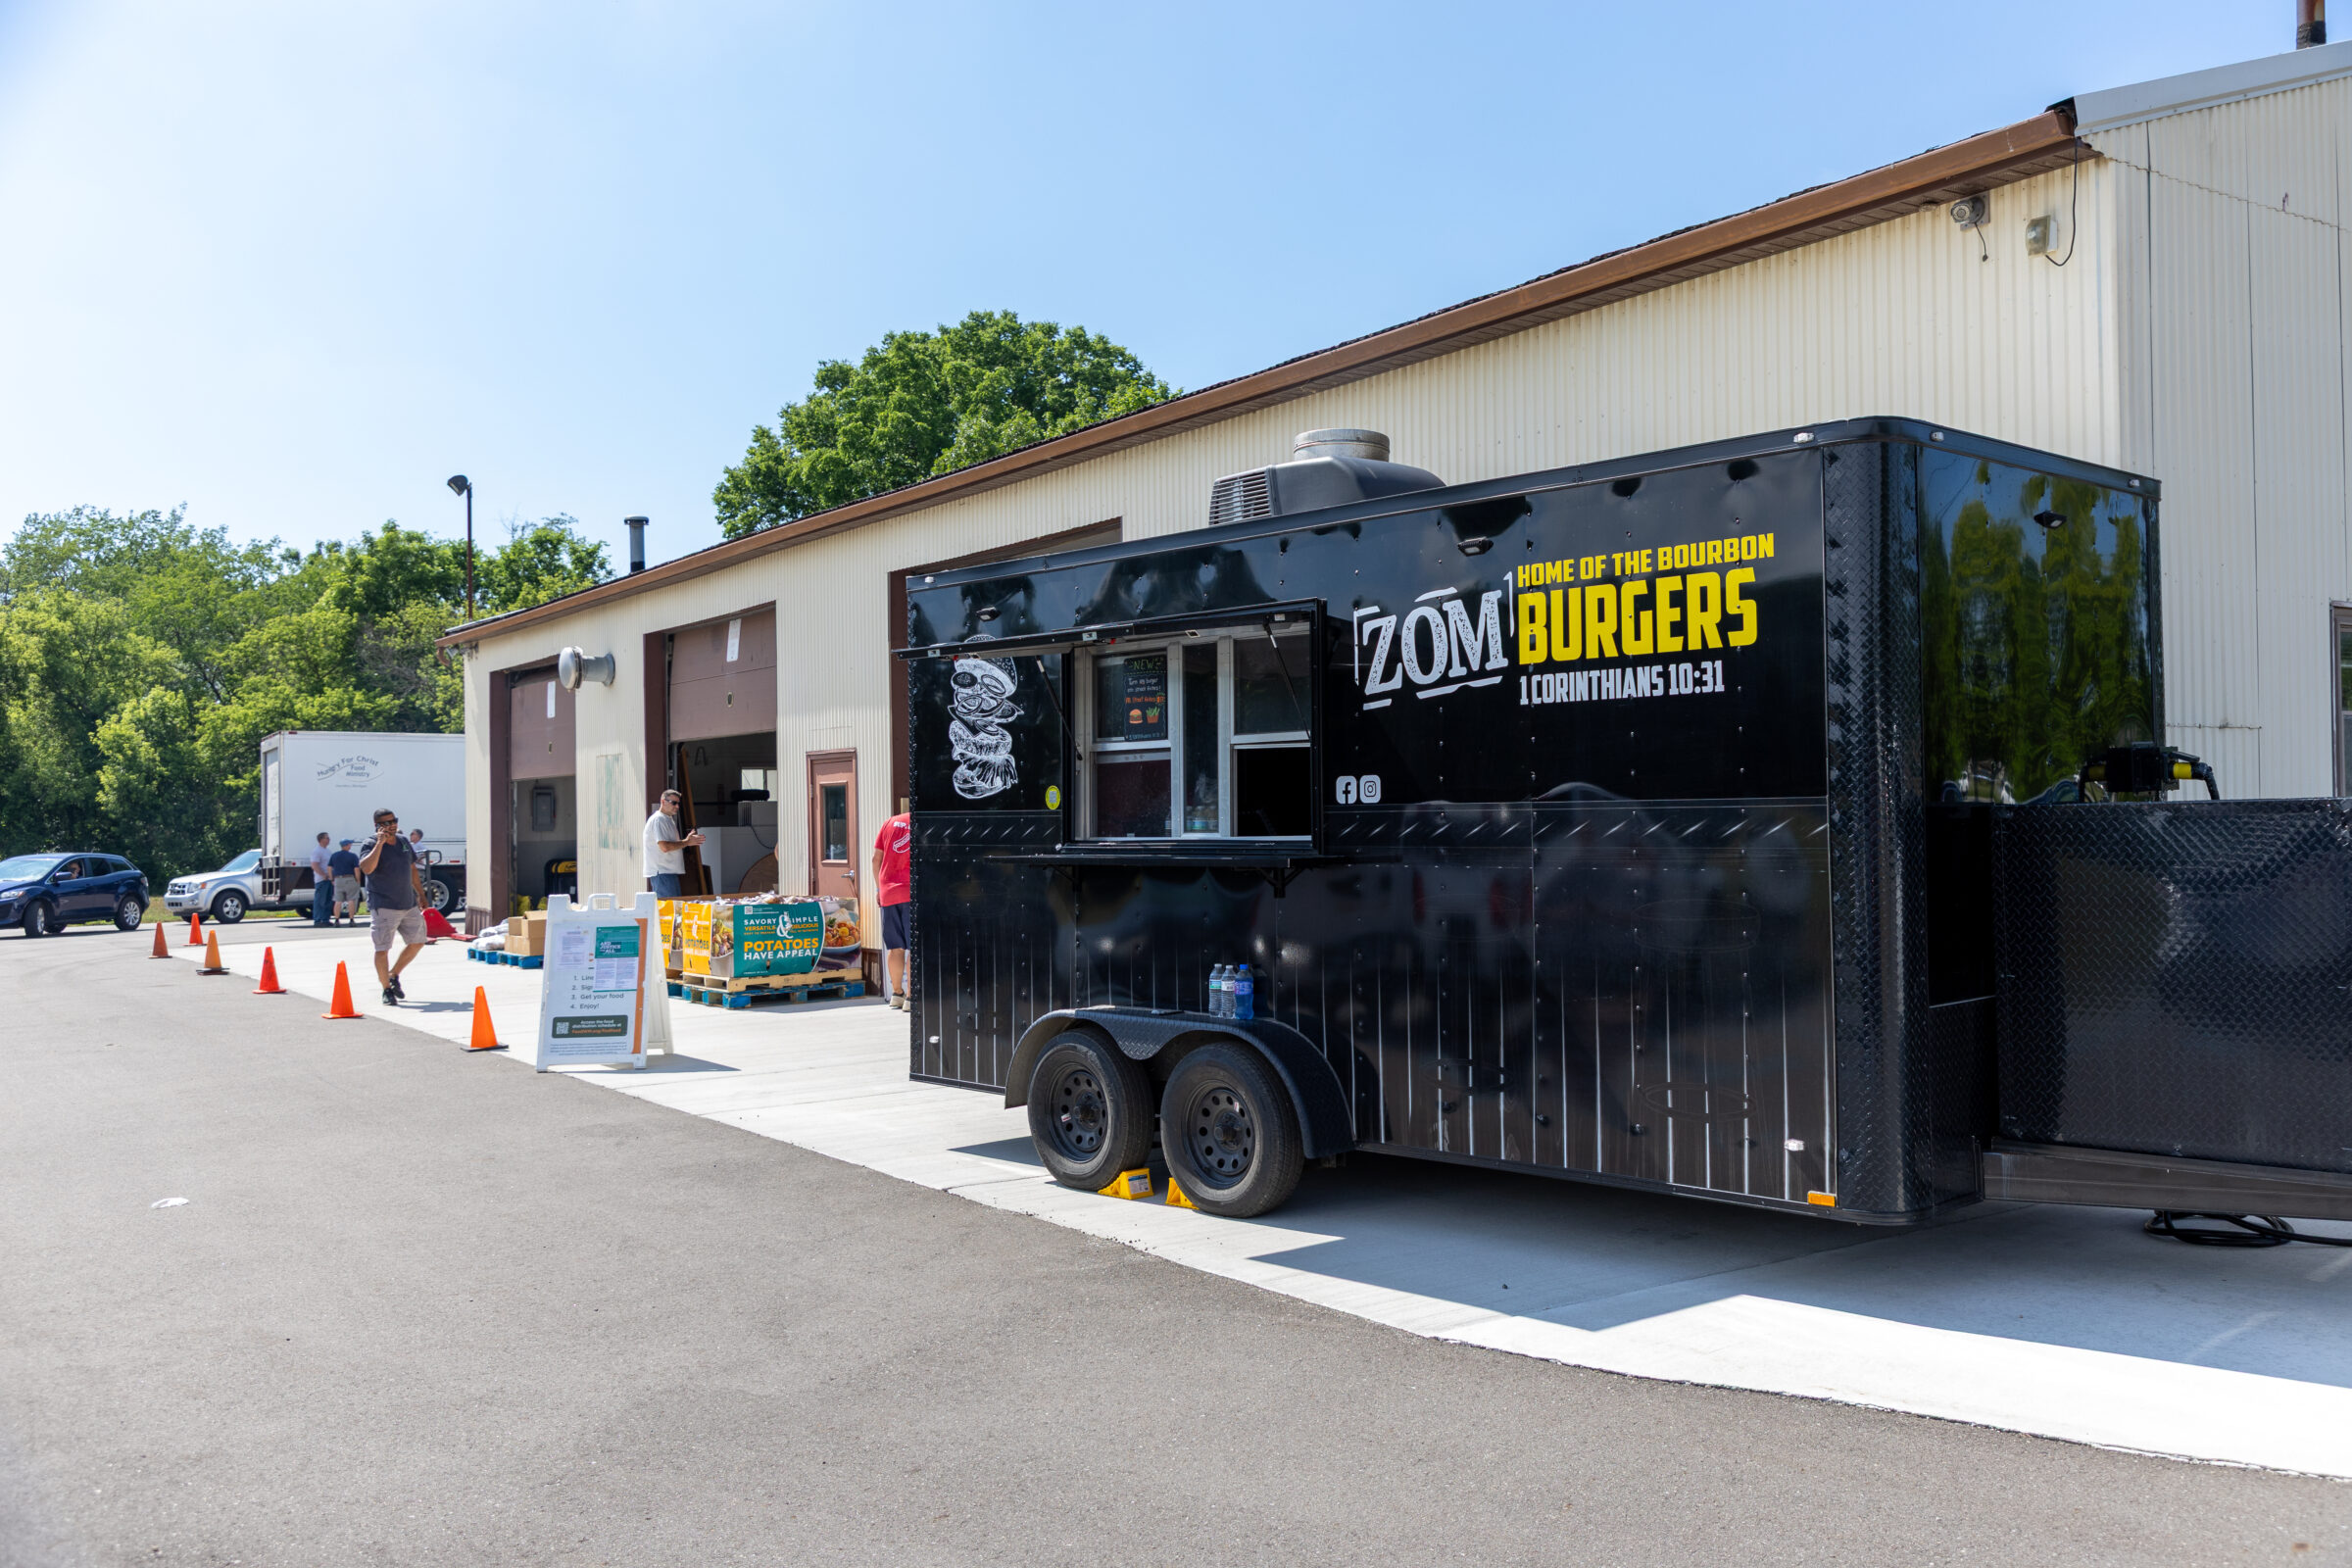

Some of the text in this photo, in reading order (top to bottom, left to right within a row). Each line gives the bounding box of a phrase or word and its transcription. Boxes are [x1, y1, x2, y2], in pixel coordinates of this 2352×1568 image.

[1518, 532, 1775, 588] HOME OF THE BOURBON
[1518, 566, 1758, 665] BURGERS
[1362, 590, 1509, 696] ZOM
[1519, 660, 1725, 706] 1 CORINTHIANS 10:31
[317, 762, 340, 777] Hungry
[356, 756, 379, 766] Christ
[744, 917, 777, 926] SAVORY
[744, 938, 819, 953] POTATOES
[744, 948, 819, 960] HAVE APPEAL
